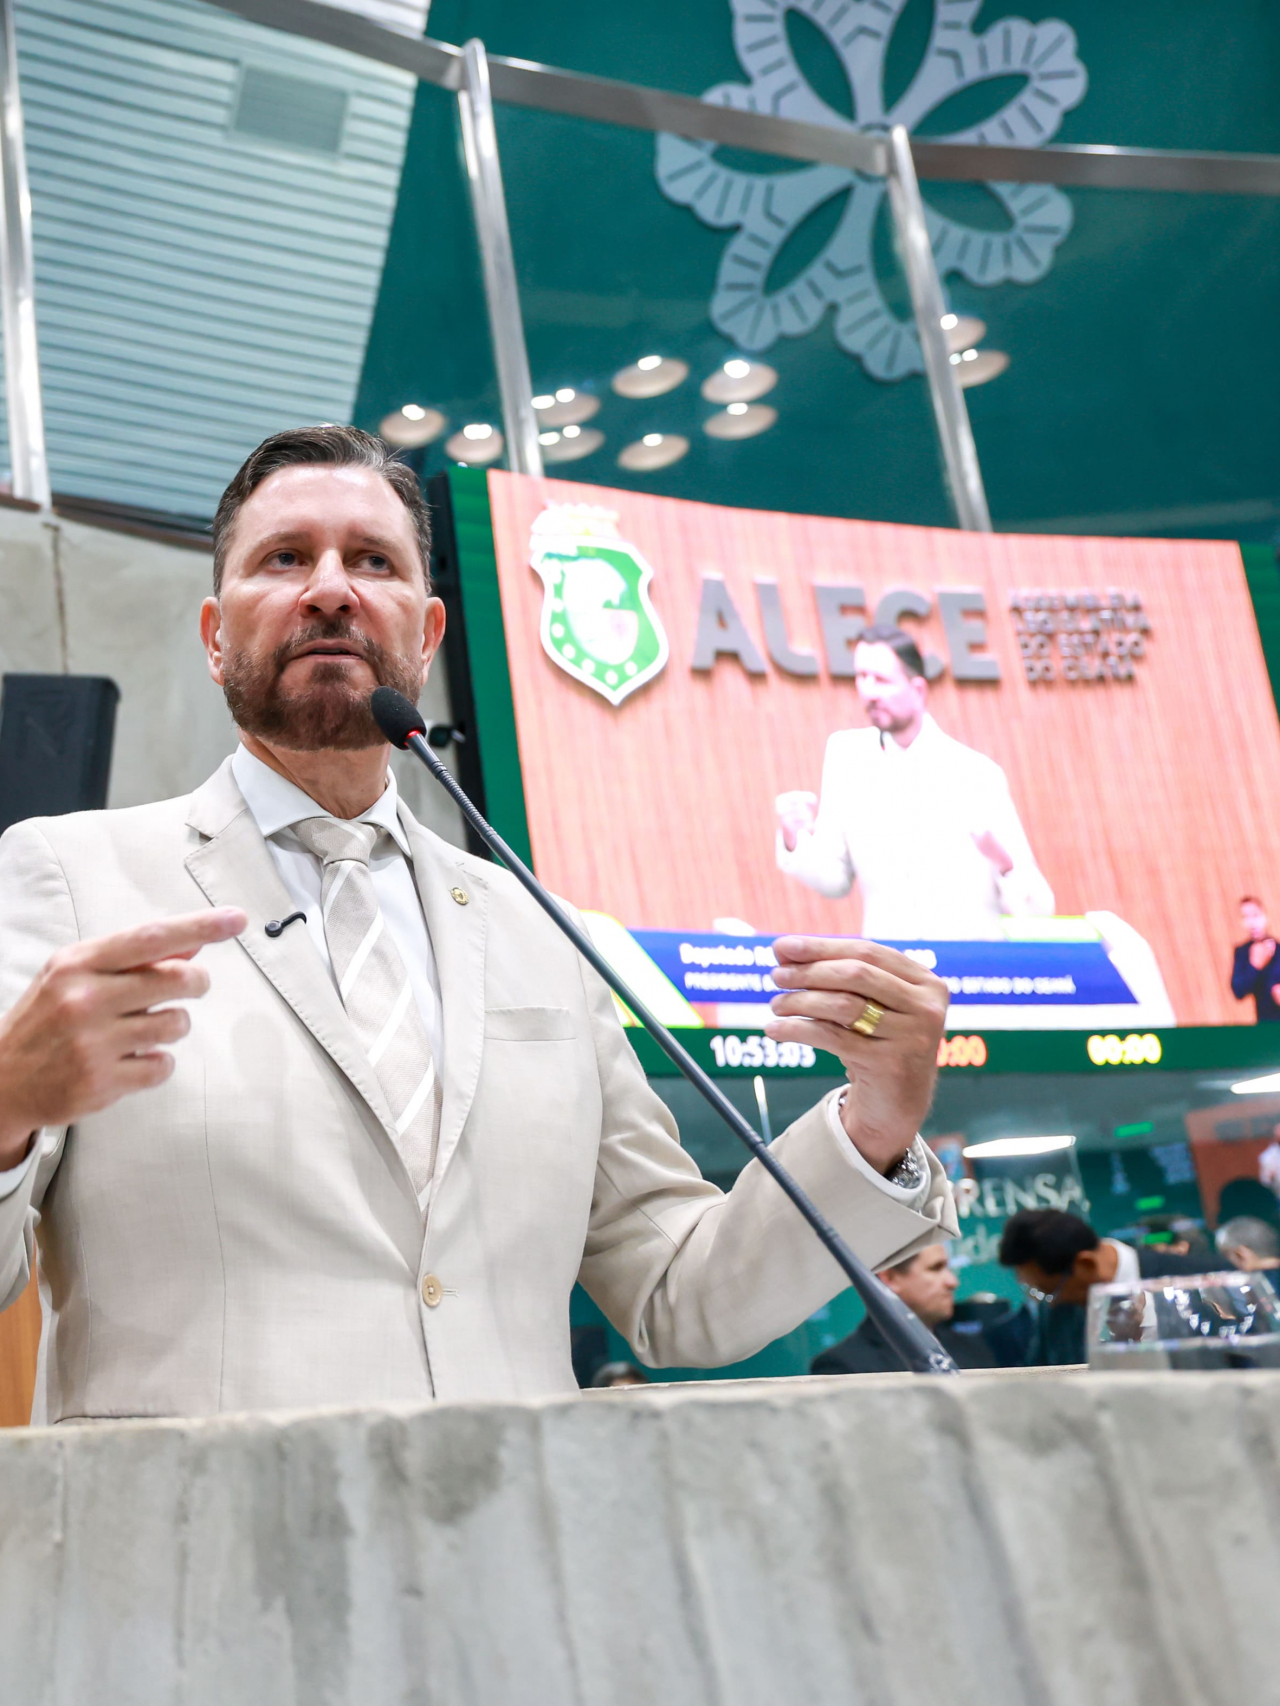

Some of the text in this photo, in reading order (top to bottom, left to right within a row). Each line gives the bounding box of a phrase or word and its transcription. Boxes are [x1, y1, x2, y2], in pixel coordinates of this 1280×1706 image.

[691, 574, 1001, 681] ALECE
[1087, 1033, 1162, 1066] 00:00
[947, 1172, 1091, 1219] RENSA
